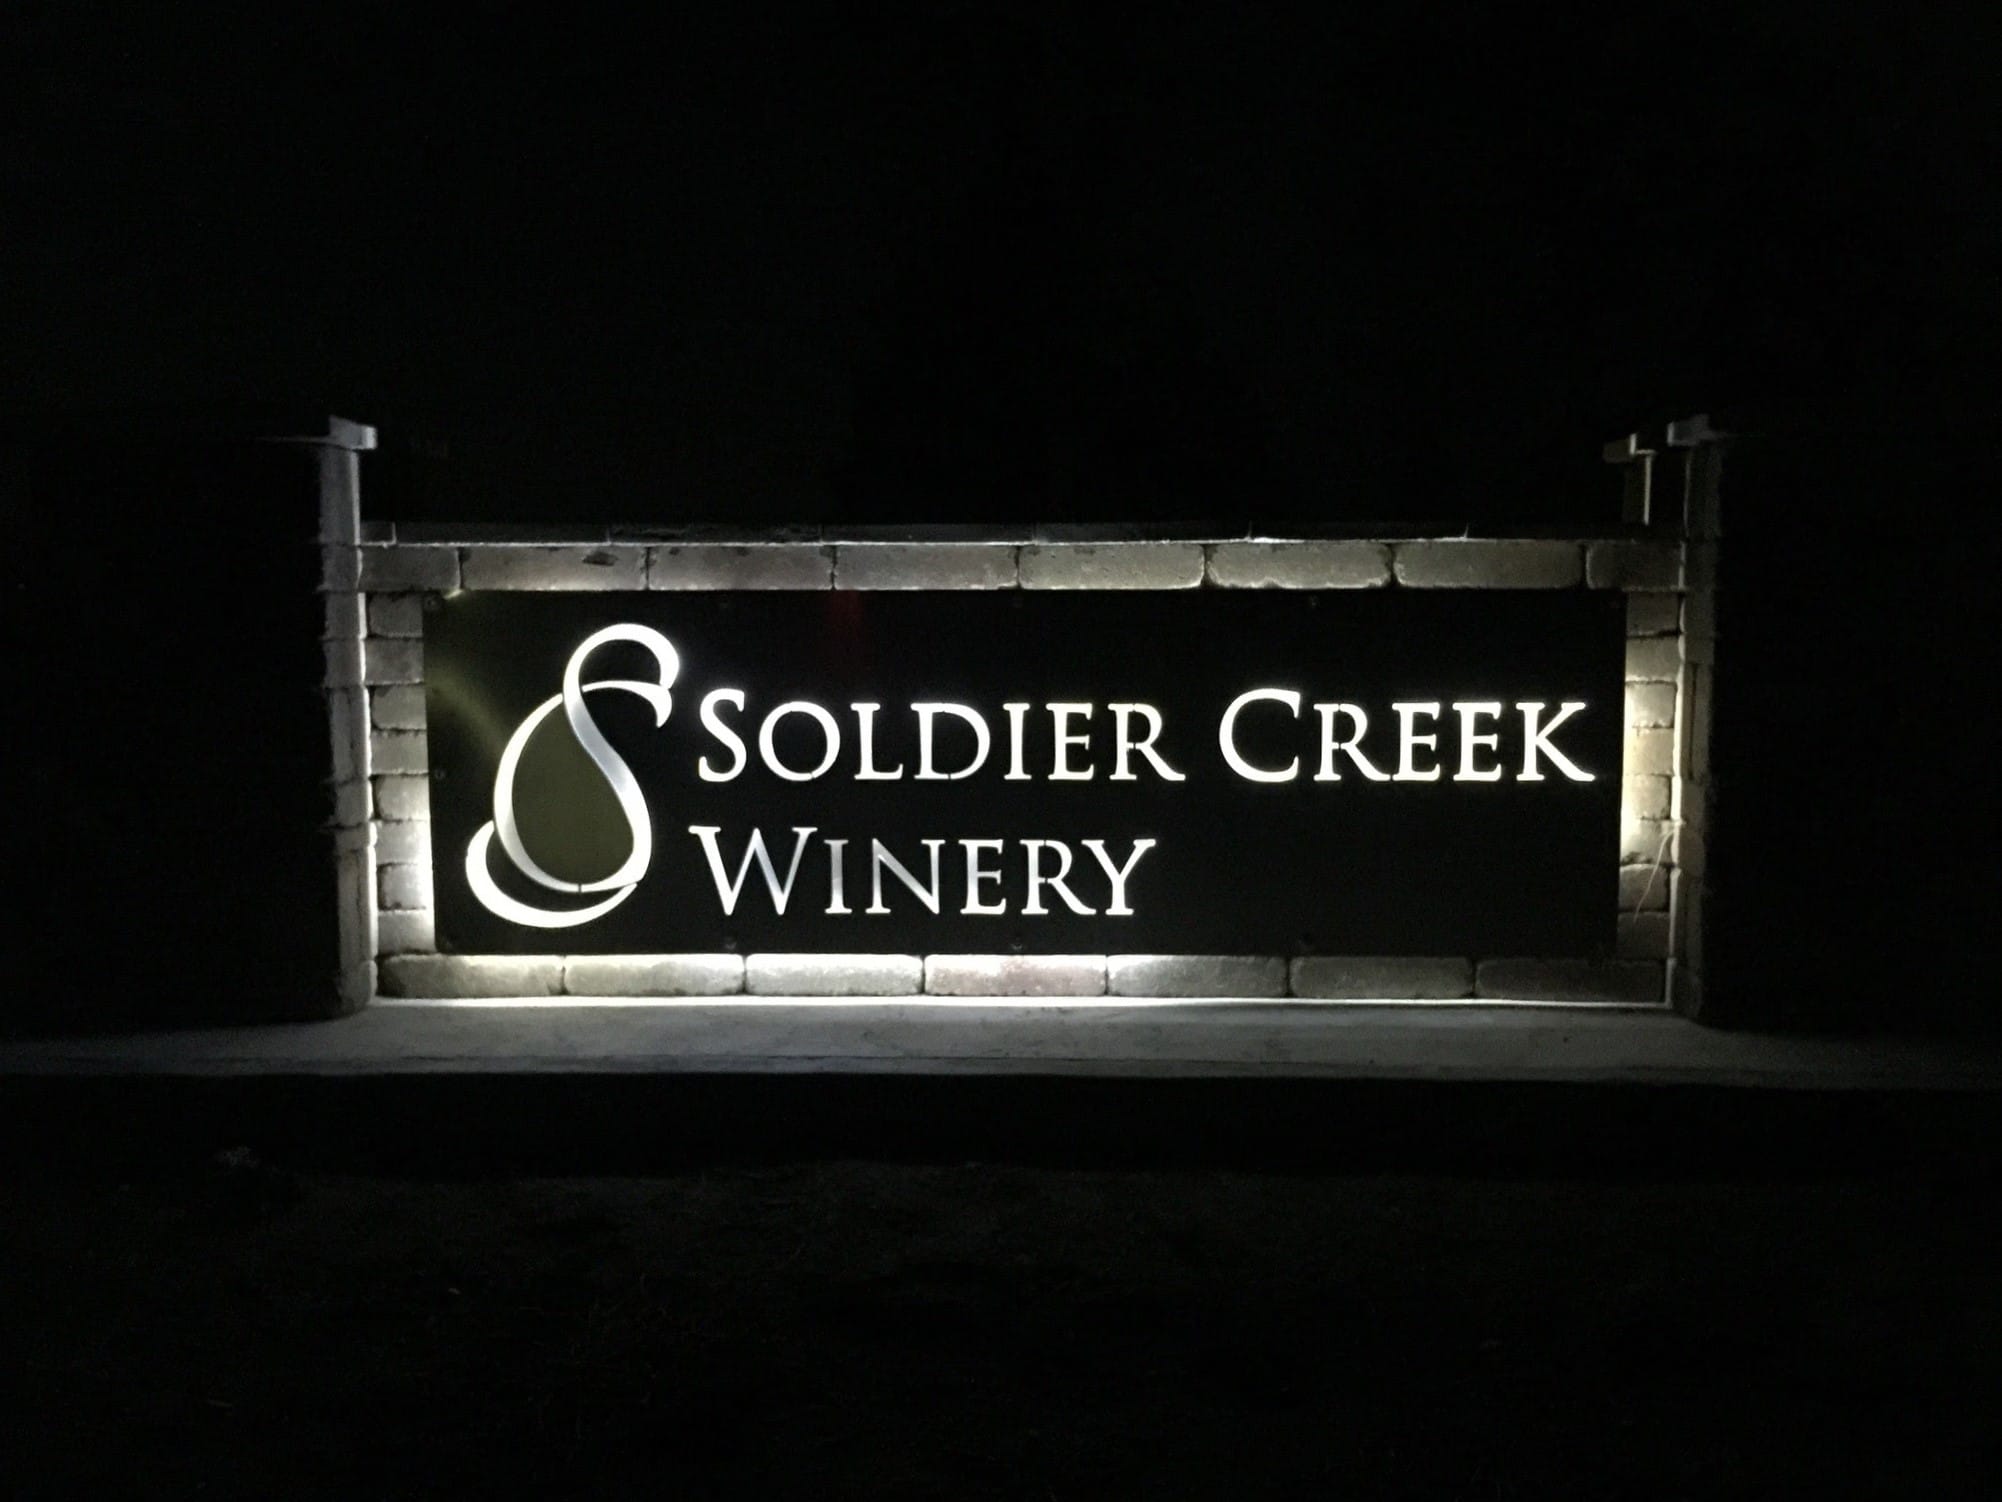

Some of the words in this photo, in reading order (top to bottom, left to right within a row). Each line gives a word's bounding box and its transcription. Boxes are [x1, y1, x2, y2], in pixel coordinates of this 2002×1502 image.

[698, 687, 1187, 783] SOLDIER
[1219, 687, 1597, 783] CREEK
[688, 824, 1157, 916] WINERY
